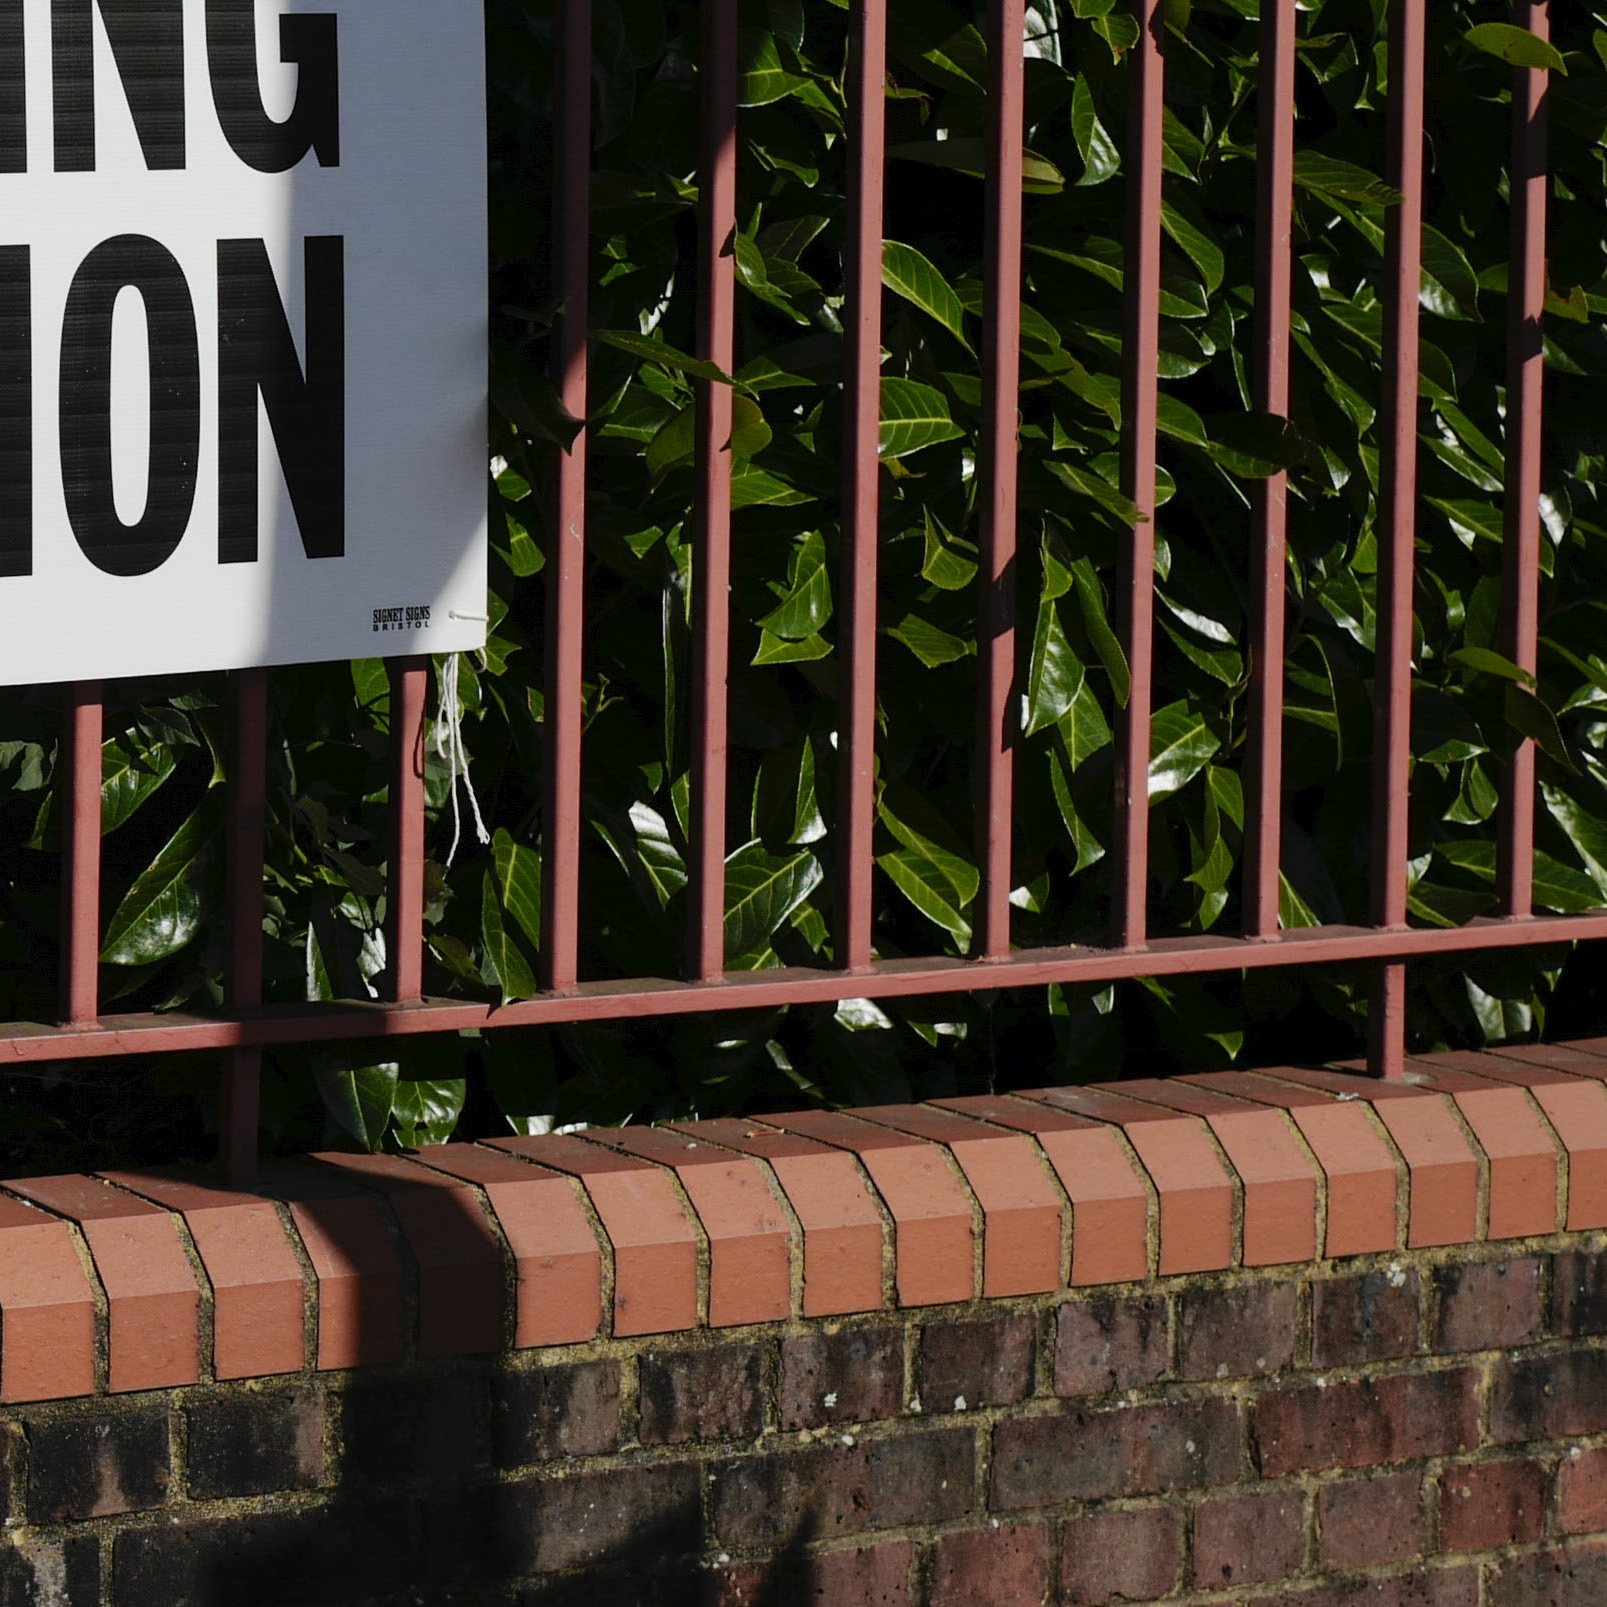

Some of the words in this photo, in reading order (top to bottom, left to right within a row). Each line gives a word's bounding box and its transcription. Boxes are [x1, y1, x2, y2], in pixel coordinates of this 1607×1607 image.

[372, 607, 404, 624] SIGNET
[405, 605, 431, 621] SIGNS
[372, 621, 431, 632] BRISTOL
